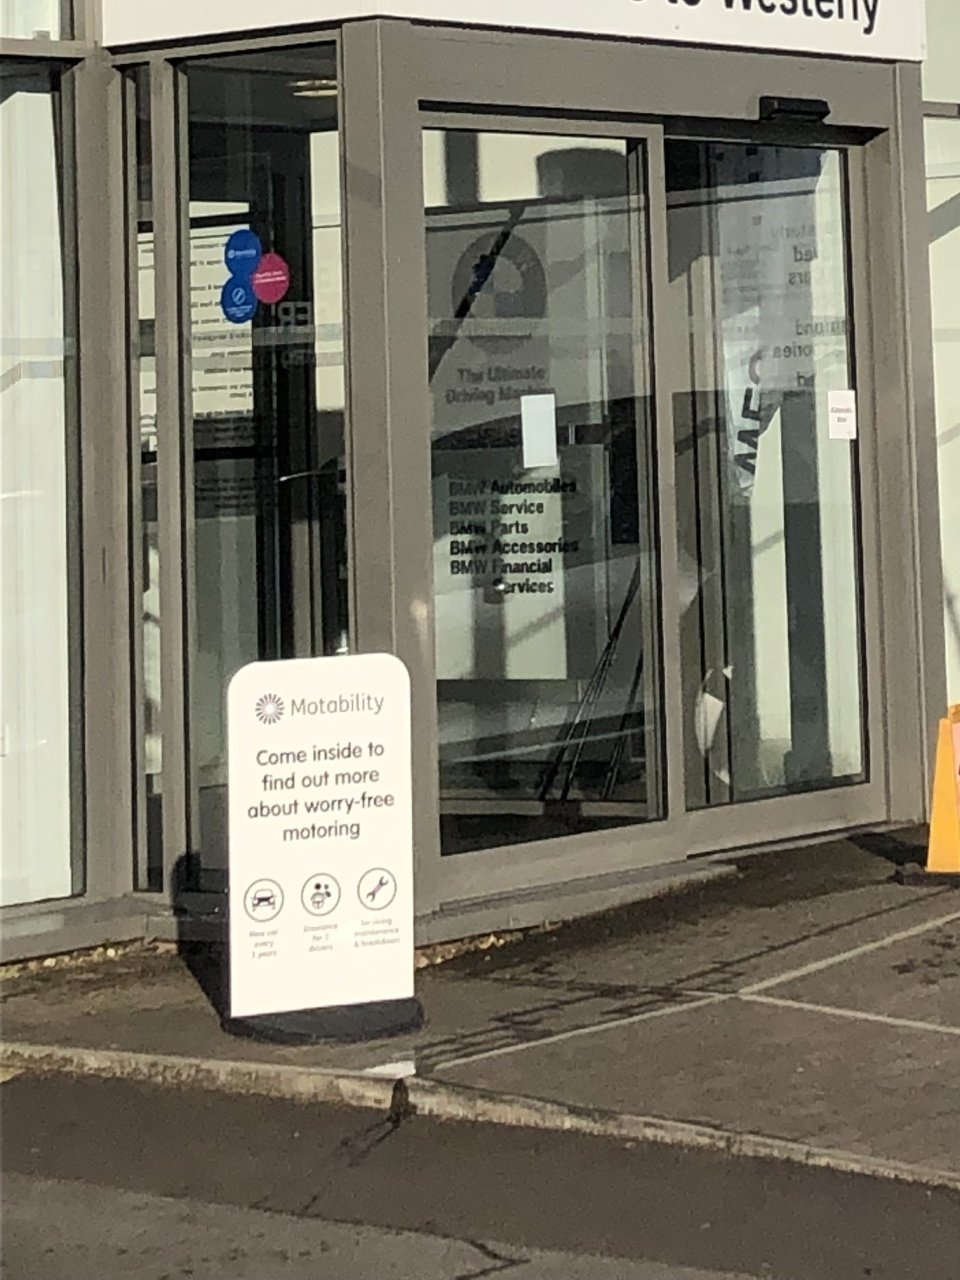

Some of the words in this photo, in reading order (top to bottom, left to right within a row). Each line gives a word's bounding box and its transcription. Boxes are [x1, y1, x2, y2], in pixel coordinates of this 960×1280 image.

[491, 478, 577, 494] Automobiles
[491, 499, 544, 515] Service
[491, 520, 529, 535] Parts
[492, 537, 579, 554] Accessories
[492, 558, 552, 574] Financial
[492, 577, 555, 594] Services
[290, 693, 385, 717] Motability
[256, 749, 307, 766] Come
[312, 742, 363, 762] inside
[368, 741, 385, 757] to
[262, 772, 296, 792] find
[301, 771, 329, 788] out
[335, 770, 380, 786] more
[247, 799, 299, 819] about
[304, 791, 395, 815] worry-free
[283, 819, 361, 842] motoring
